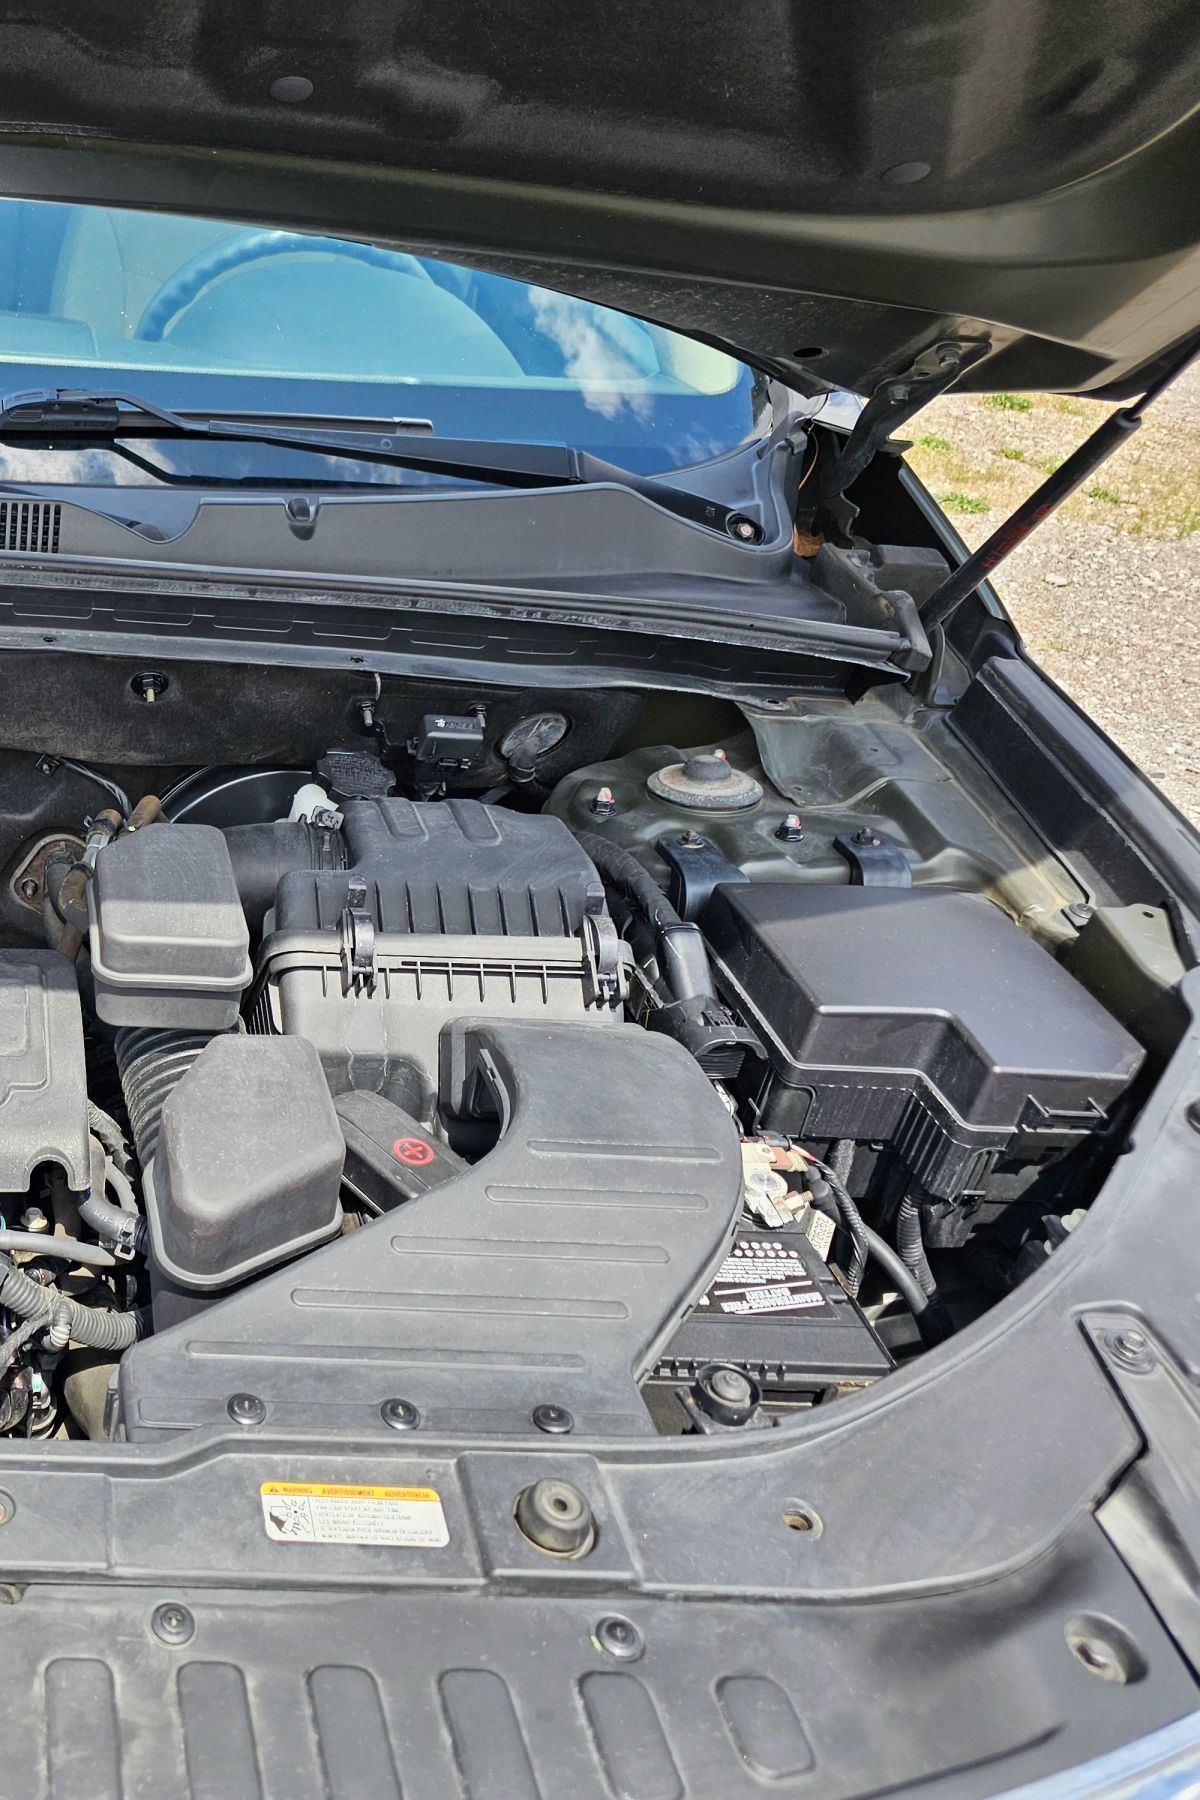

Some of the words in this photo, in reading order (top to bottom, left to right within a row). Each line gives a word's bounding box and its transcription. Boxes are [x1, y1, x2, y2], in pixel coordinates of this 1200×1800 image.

[745, 1287, 791, 1301] BATTERY
[720, 1291, 823, 1313] MAINTENANCE-FREE
[321, 1488, 375, 1498] AVERTISSEMENT
[384, 1490, 430, 1500] ADVERTENCIA
